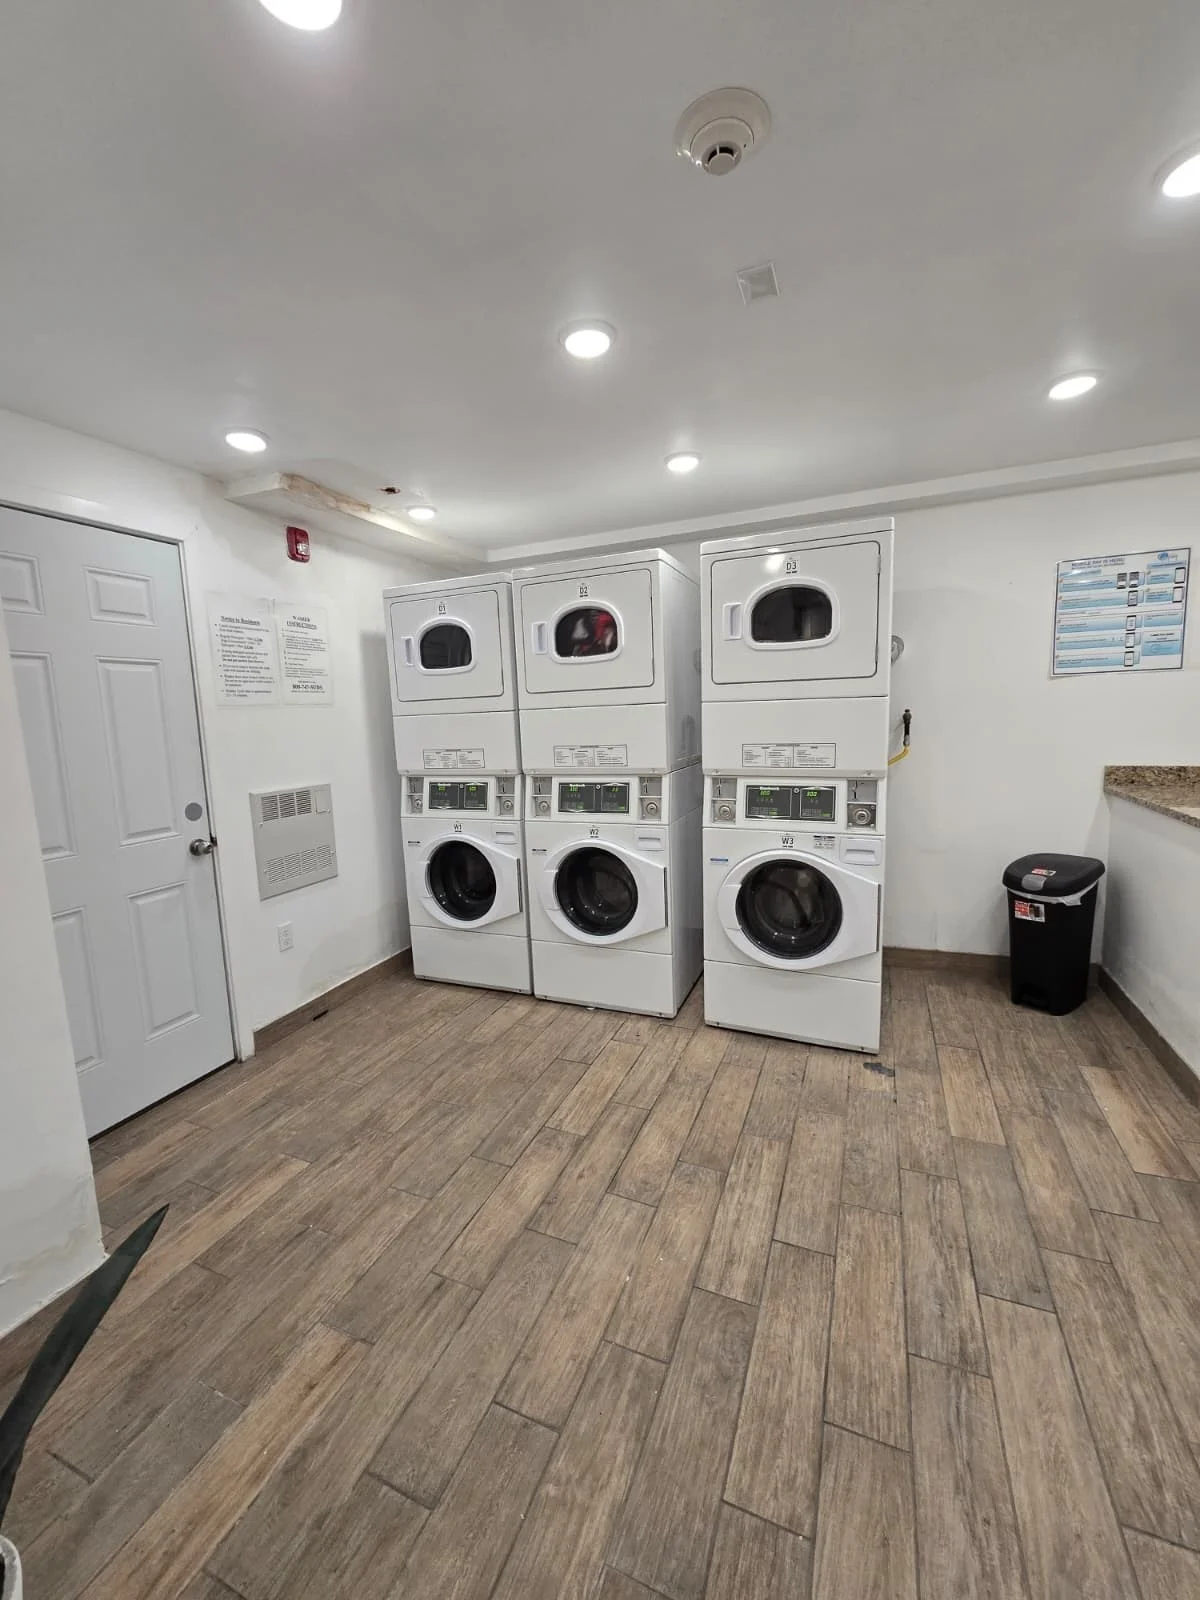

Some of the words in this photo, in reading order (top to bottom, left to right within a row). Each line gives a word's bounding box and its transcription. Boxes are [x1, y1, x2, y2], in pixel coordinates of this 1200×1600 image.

[786, 561, 797, 570] D3
[580, 586, 588, 594] D2
[781, 837, 794, 845] W3
